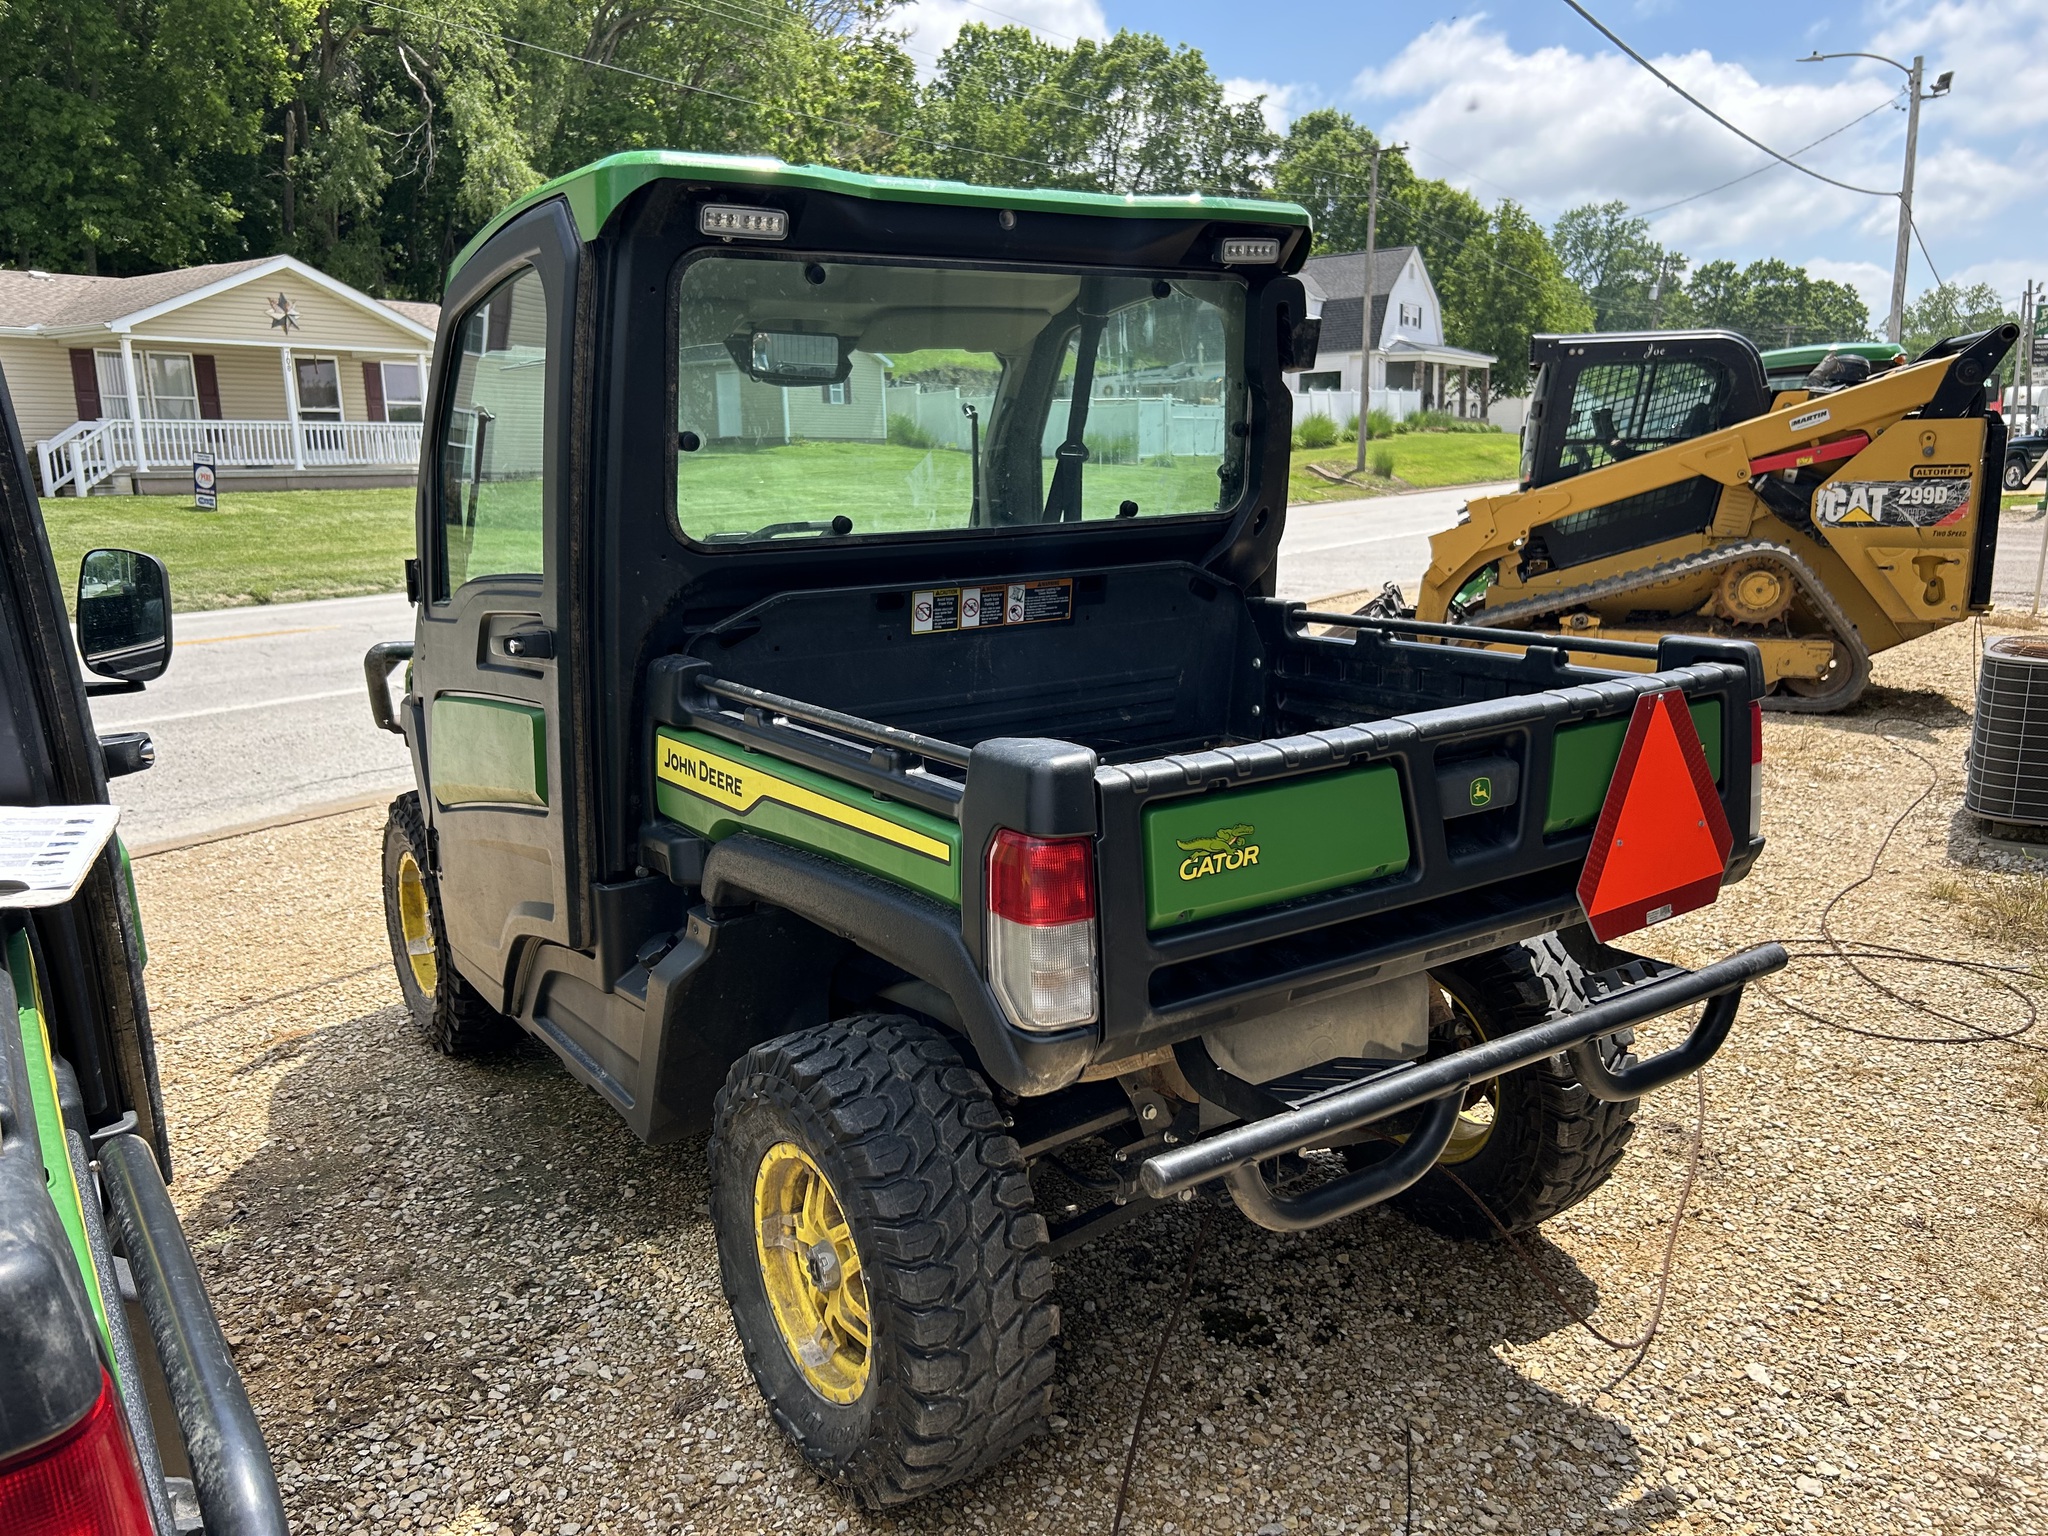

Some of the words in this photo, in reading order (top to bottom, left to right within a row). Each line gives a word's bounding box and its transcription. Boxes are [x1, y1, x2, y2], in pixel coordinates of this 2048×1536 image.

[1643, 343, 1666, 360] Joe
[1792, 410, 1828, 426] MARTIN
[1916, 468, 1967, 477] ALTORFER
[1825, 487, 1889, 522] CAT
[664, 747, 696, 779] JOHN
[699, 759, 743, 798] DEERE
[1179, 844, 1260, 882] GATOR
